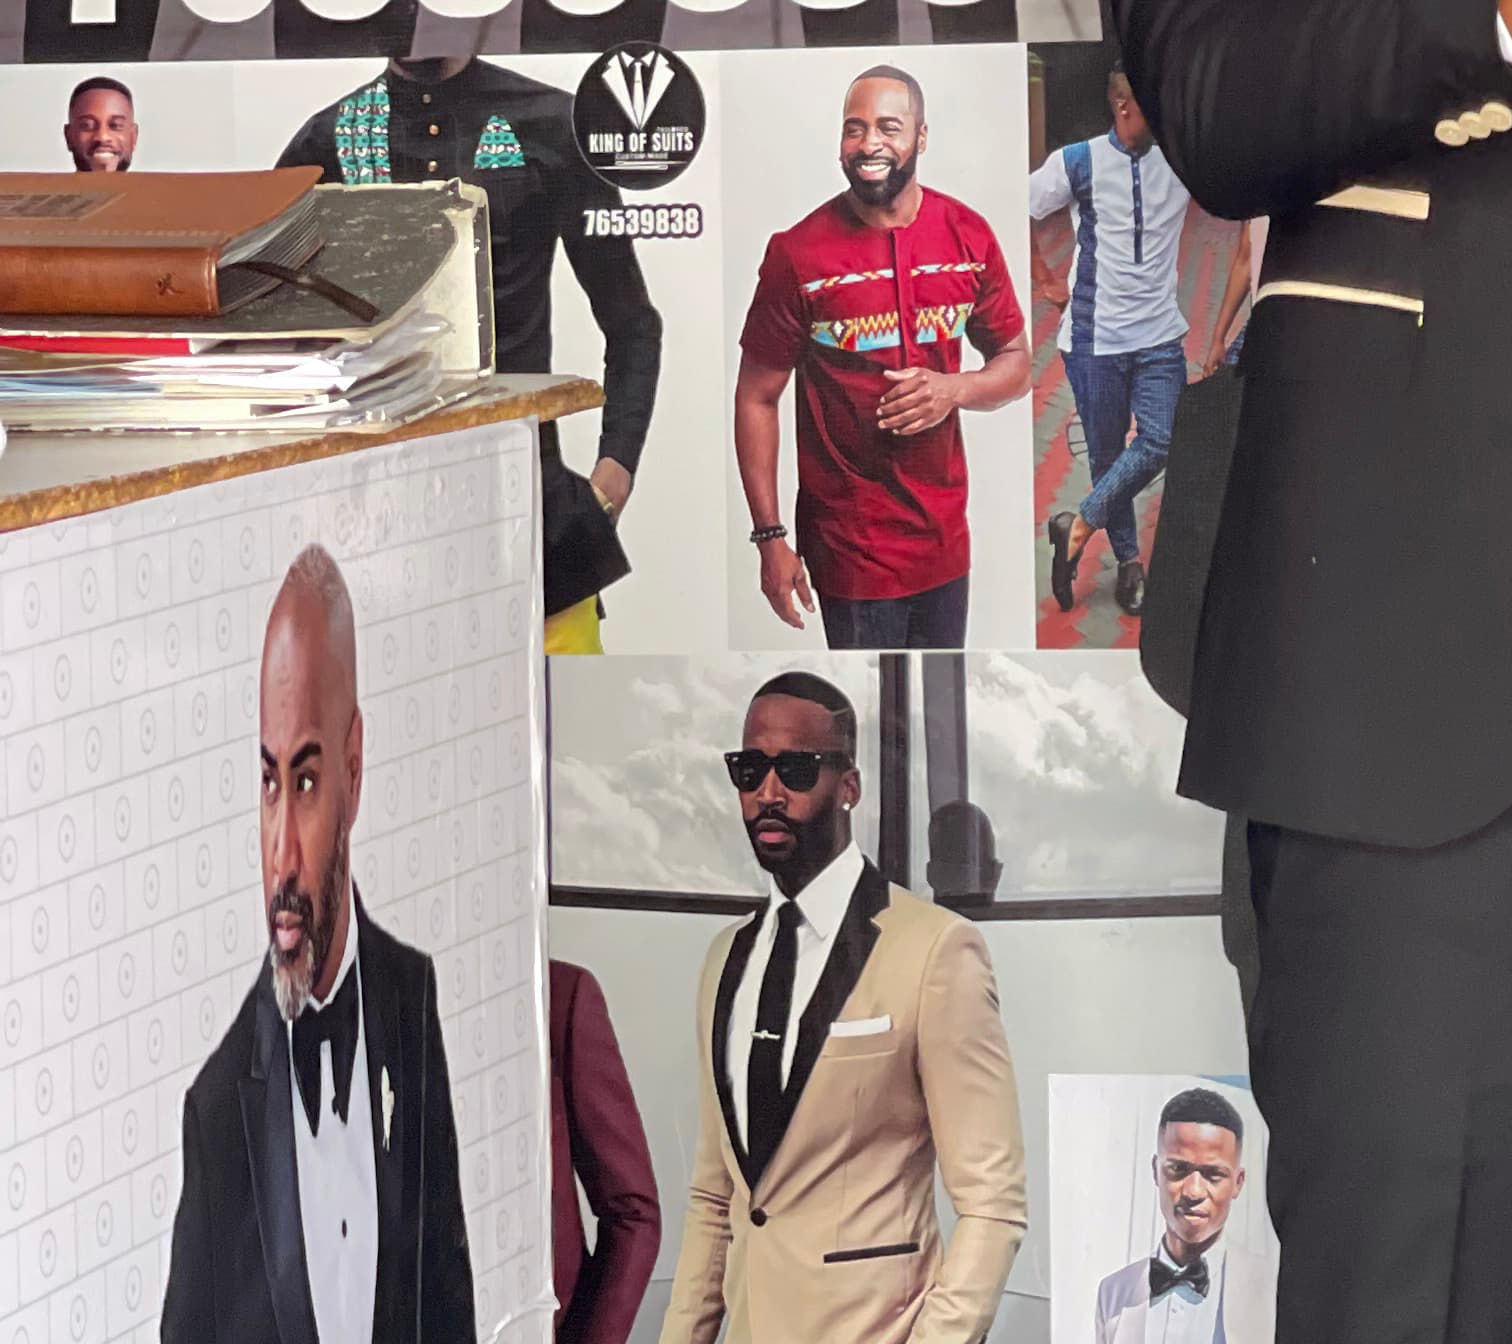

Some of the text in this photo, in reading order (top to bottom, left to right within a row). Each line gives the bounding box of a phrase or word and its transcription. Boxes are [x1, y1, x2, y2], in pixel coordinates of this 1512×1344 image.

[589, 132, 694, 153] KING OF SUITS
[583, 208, 700, 237] 76539838
